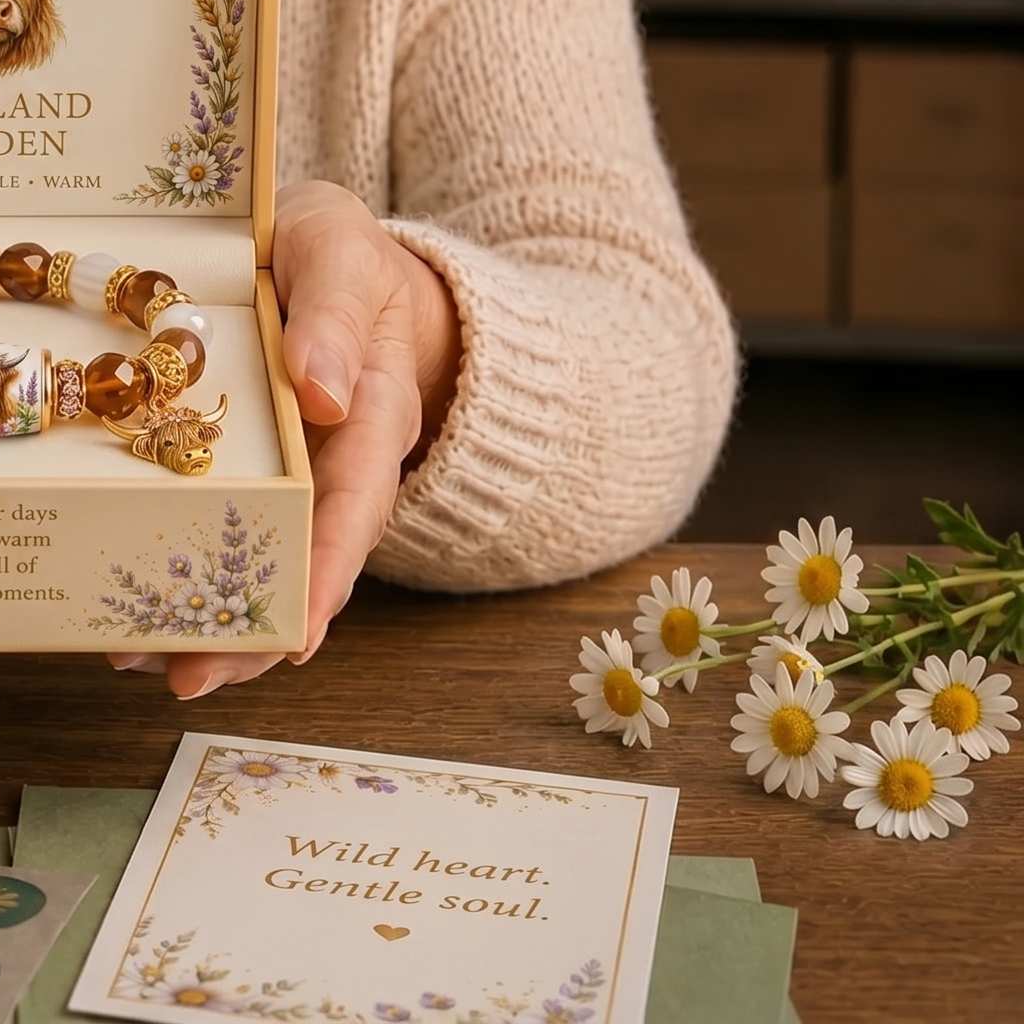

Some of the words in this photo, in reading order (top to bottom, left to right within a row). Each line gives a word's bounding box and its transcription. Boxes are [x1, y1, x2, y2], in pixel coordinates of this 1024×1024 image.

[43, 175, 102, 189] WARM
[11, 503, 58, 525] days
[16, 556, 39, 574] of
[284, 835, 401, 868] Wild
[412, 850, 551, 886] heart.
[264, 868, 423, 905] Gentle
[438, 895, 549, 921] soul.
